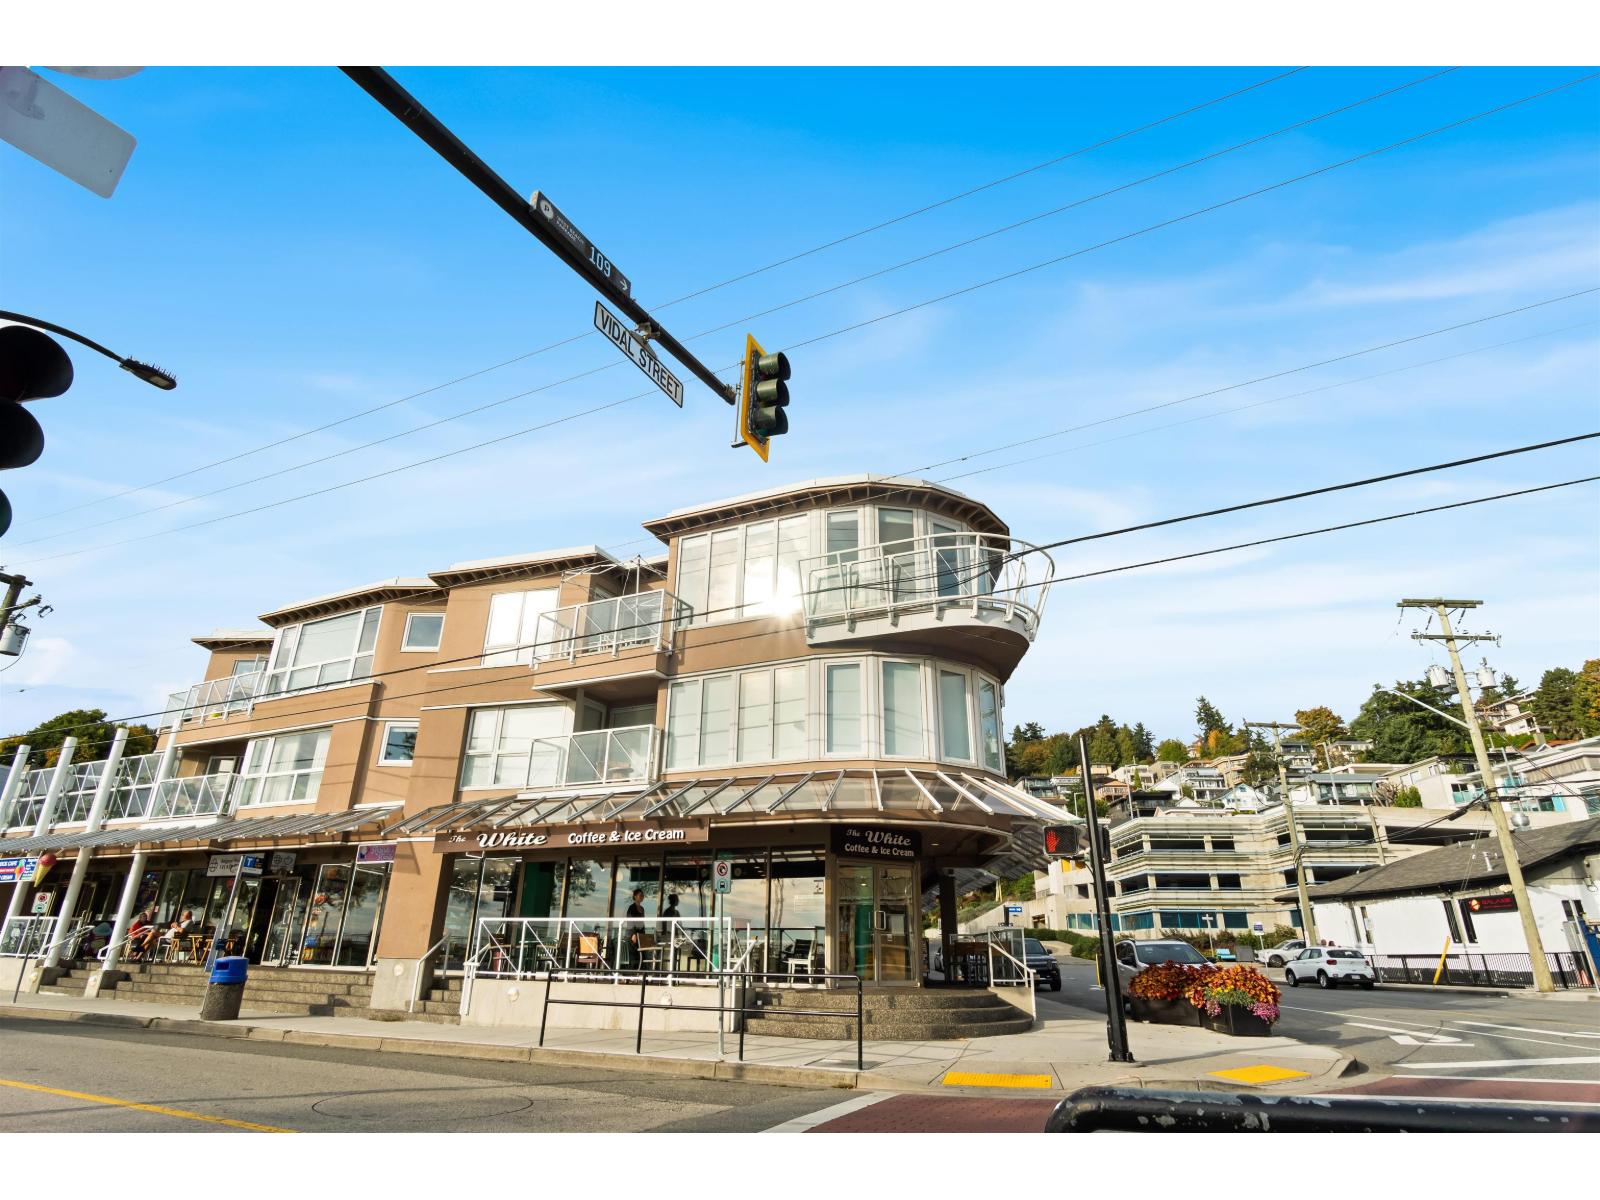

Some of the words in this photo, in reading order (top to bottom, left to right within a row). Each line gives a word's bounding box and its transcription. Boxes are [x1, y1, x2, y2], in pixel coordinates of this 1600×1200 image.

[589, 246, 611, 278] 109
[600, 309, 635, 357] VIDAL
[638, 348, 680, 399] STREET
[448, 835, 467, 844] The
[476, 832, 548, 848] White
[567, 831, 607, 845] Coffee
[608, 830, 622, 842] &
[624, 830, 643, 842] Ice
[645, 828, 685, 841] Cream
[846, 828, 861, 837] The
[865, 830, 912, 846] White
[844, 843, 870, 854] Coffee
[871, 846, 879, 854] &
[880, 846, 891, 855] Ice
[892, 847, 915, 857] Cream
